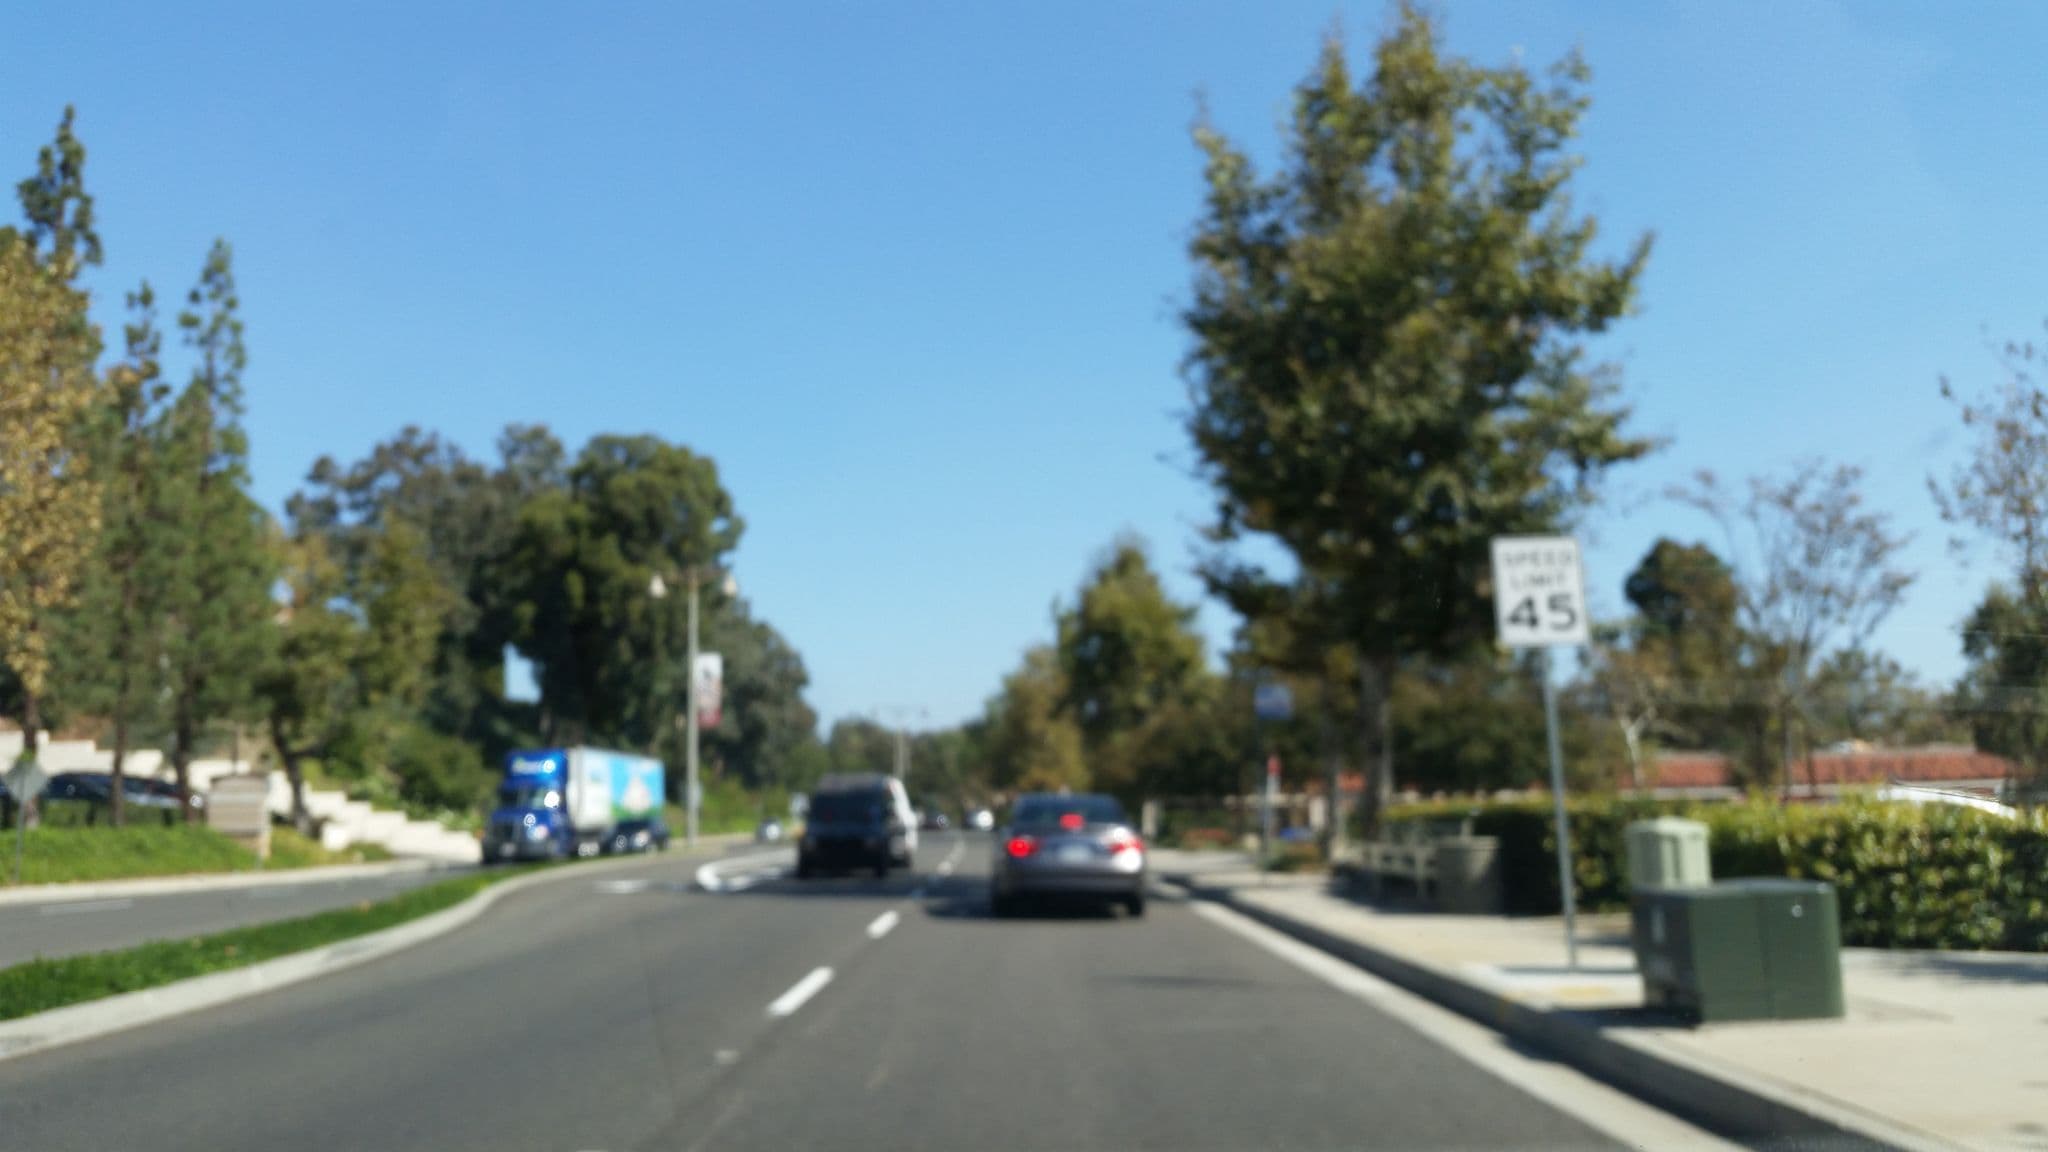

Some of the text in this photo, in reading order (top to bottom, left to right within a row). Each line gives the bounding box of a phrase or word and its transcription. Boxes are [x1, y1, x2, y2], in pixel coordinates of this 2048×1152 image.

[1505, 549, 1572, 567] SPEED
[1510, 570, 1566, 590] LIMIT
[1506, 594, 1577, 631] 45
